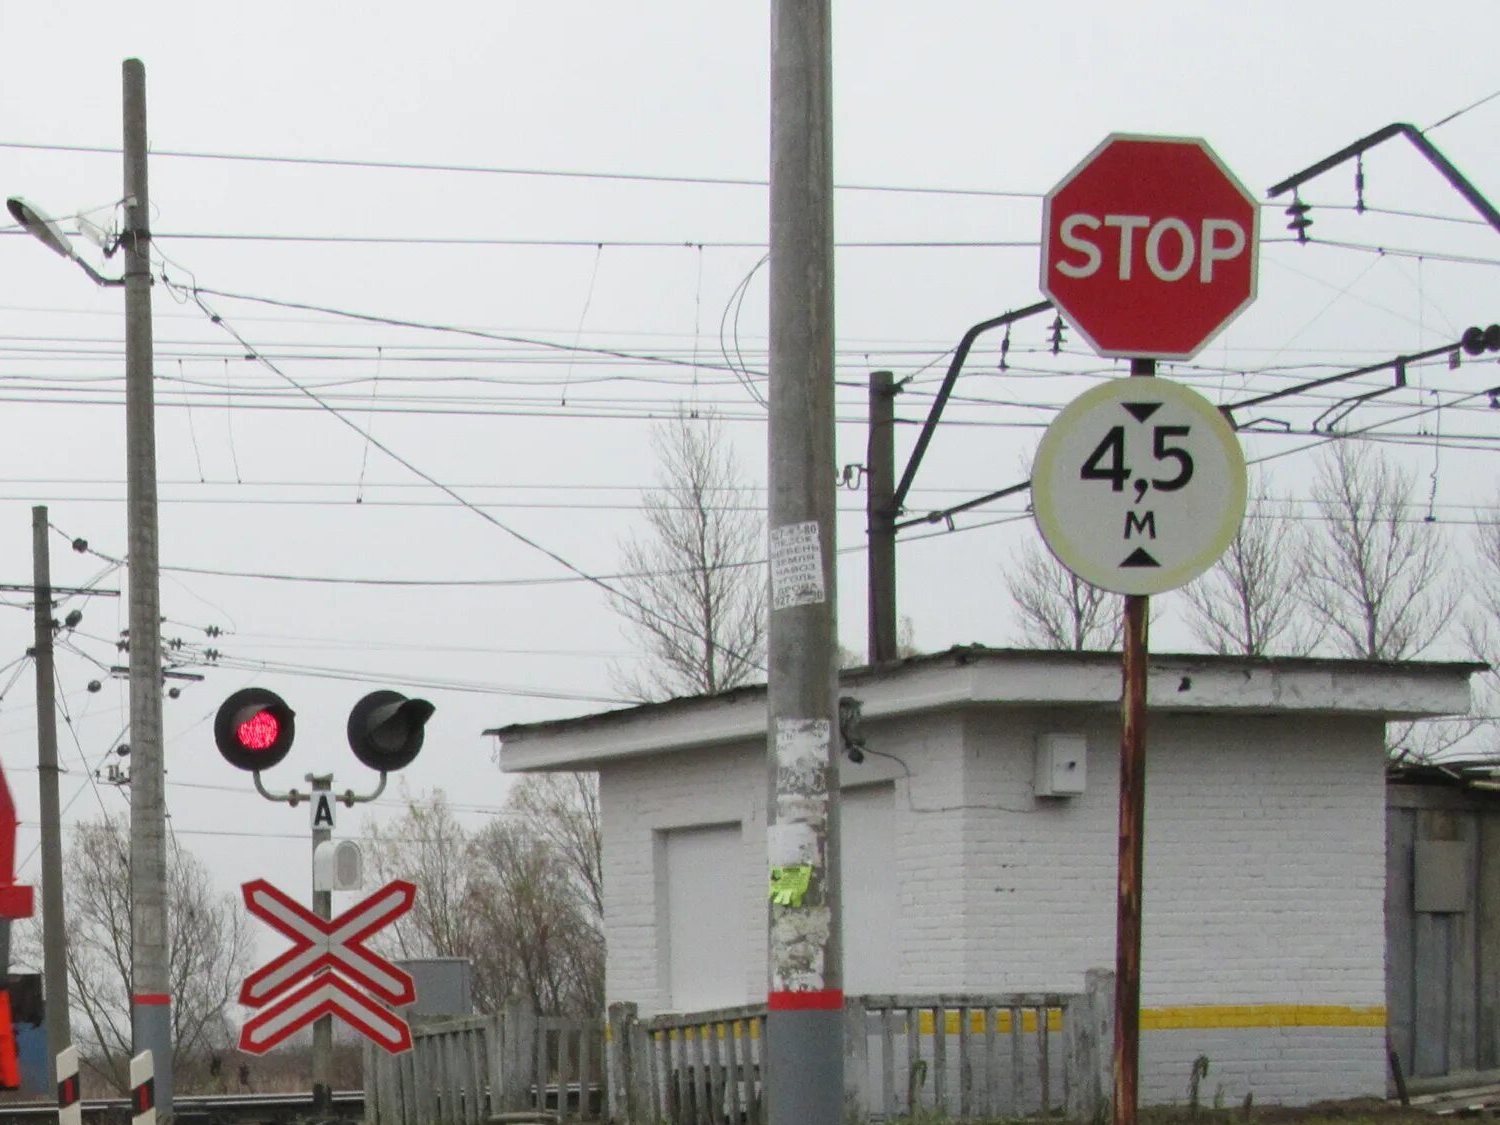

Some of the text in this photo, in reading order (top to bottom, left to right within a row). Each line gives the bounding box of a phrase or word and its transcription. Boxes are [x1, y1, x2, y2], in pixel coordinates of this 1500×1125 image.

[1055, 213, 1246, 284] STOP
[1080, 425, 1194, 504] 4,5
[775, 563, 816, 577] НАВОЗ
